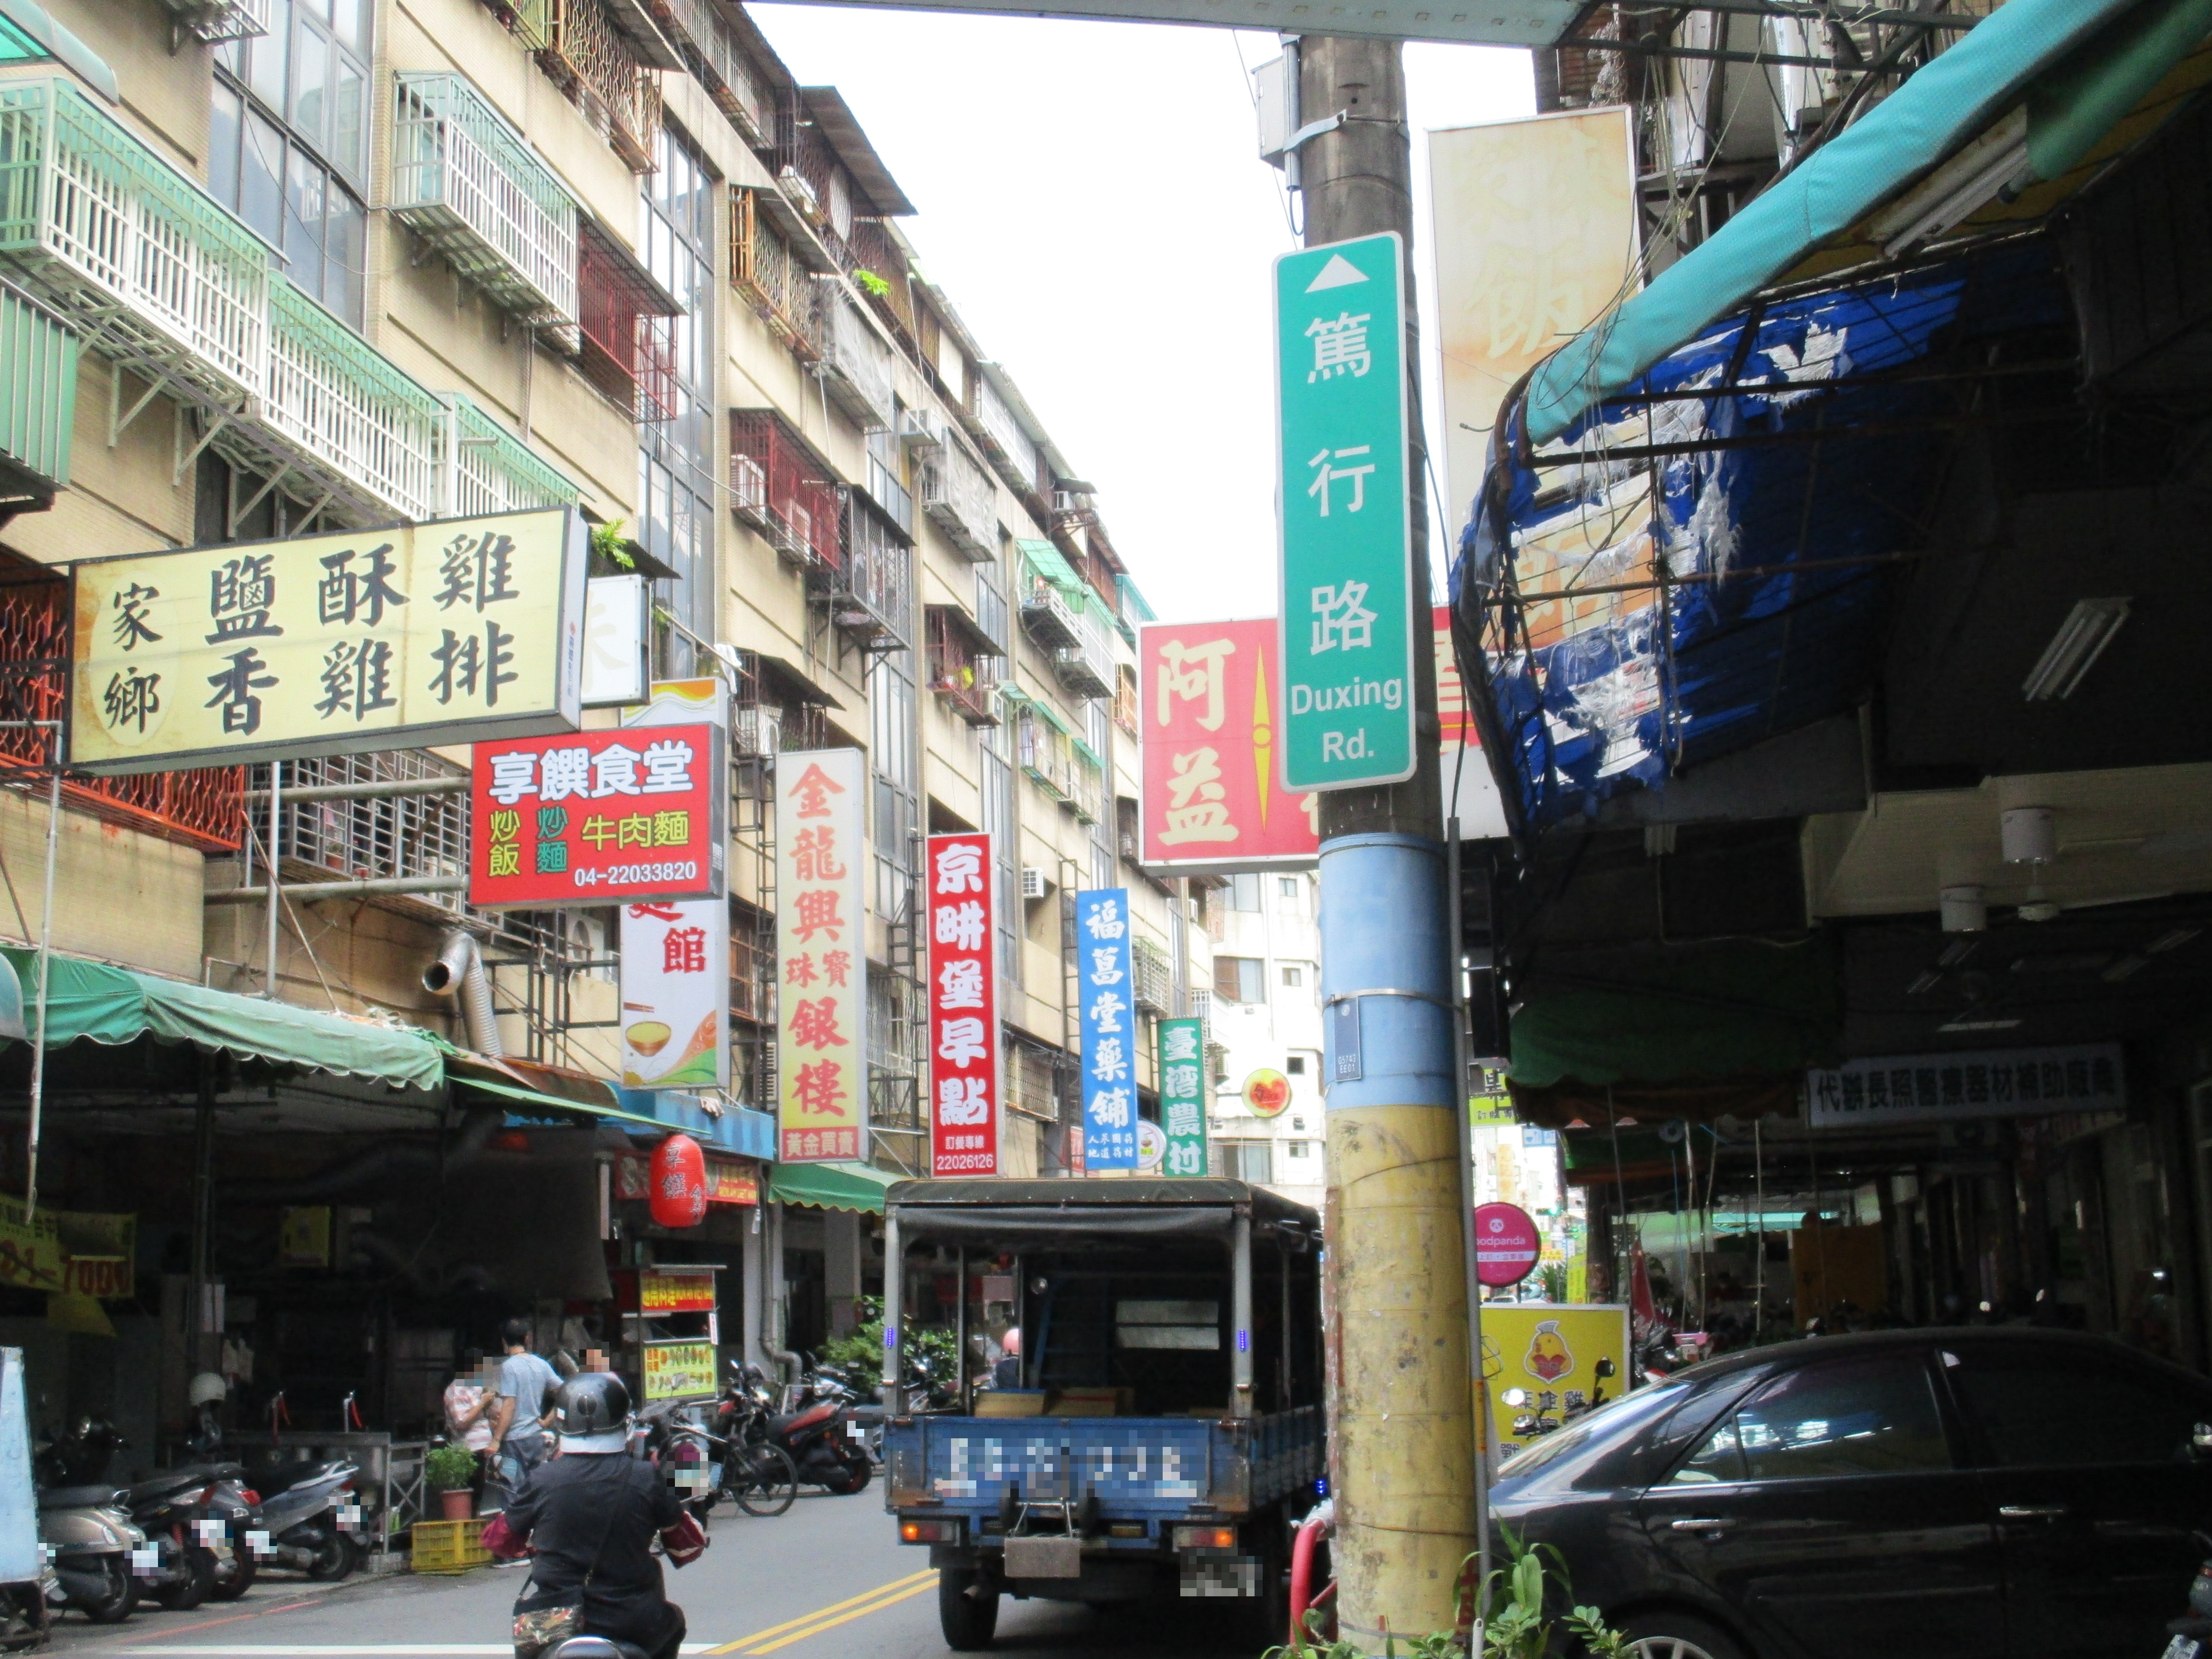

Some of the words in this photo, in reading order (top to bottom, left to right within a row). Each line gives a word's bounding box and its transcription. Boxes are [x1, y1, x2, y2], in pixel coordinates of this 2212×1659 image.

[1304, 311, 1378, 656] 篤行路
[204, 531, 519, 645] 鹽酥雞
[104, 582, 163, 735] 家鄉
[204, 620, 518, 736] 香雞排
[1291, 677, 1402, 715] Duxing
[489, 740, 693, 805] 享饌食堂
[1157, 638, 1240, 846] 阿益
[1322, 729, 1374, 763] Rd.
[489, 809, 520, 878] 炒飯
[535, 805, 568, 874] 炒麵
[582, 810, 690, 851] 牛肉麵
[574, 861, 696, 887] 04-22033820
[788, 996, 849, 1117] 銀樓
[936, 1154, 993, 1170] 22026126
[1476, 1235, 1525, 1248] oodpanda
